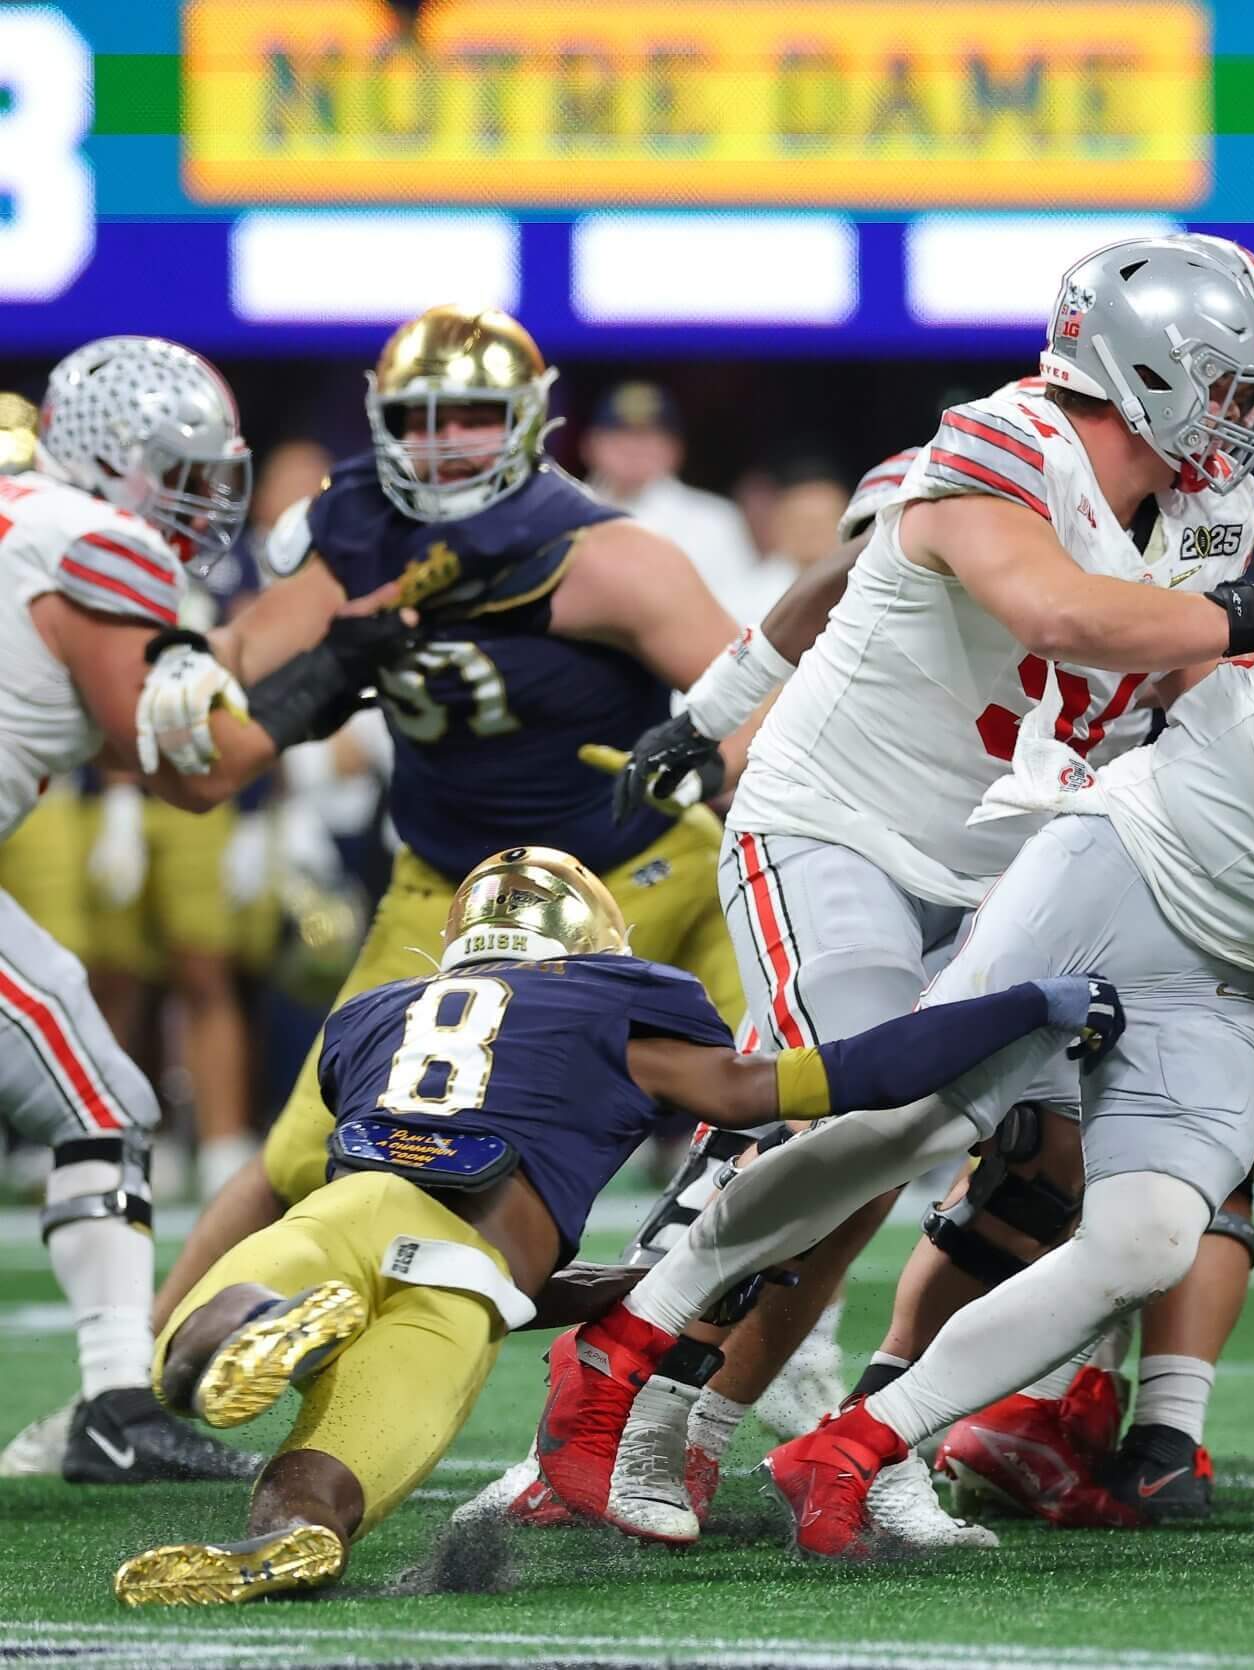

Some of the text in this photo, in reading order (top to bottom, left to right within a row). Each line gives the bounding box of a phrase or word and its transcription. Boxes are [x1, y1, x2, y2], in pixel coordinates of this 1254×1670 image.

[259, 42, 1147, 157] NOTRE DAME
[1180, 524, 1243, 561] 2025
[464, 934, 529, 955] IRISH
[376, 974, 515, 1117] 8
